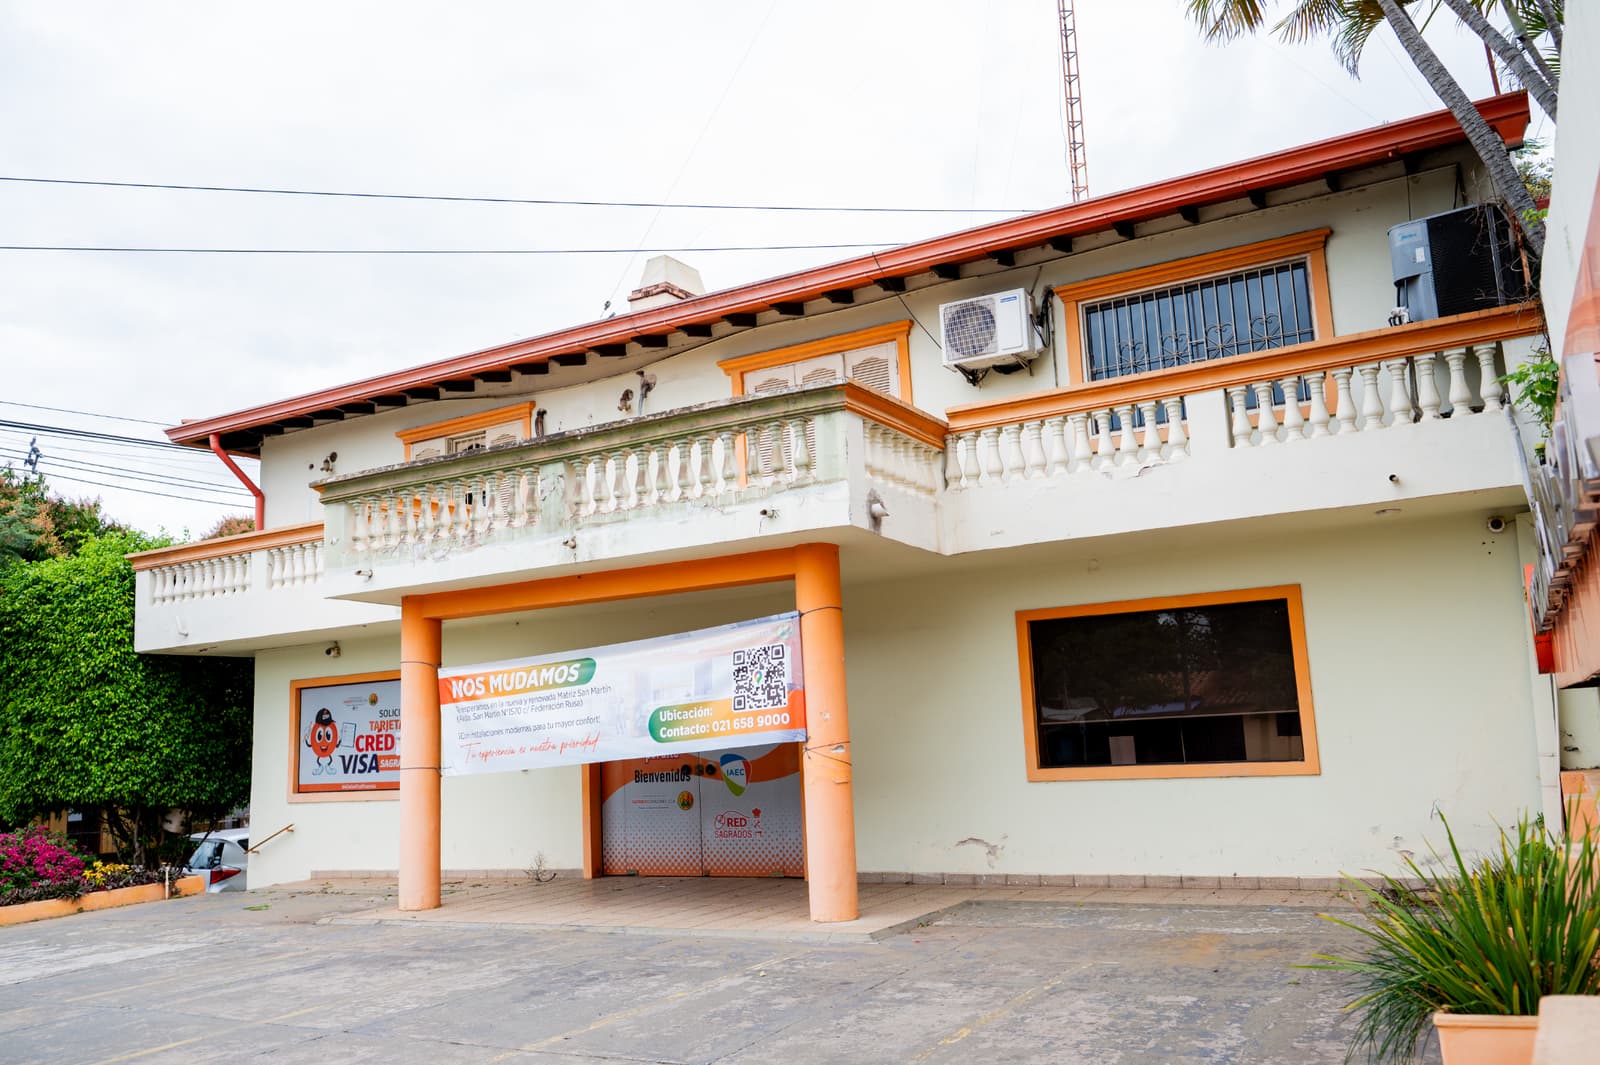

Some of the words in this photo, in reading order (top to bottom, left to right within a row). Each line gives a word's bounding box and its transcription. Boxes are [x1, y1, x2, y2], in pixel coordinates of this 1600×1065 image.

[452, 676, 486, 699] NOS
[489, 663, 582, 693] MUDAMOS
[557, 689, 577, 700] Matriz
[577, 688, 589, 697] San
[472, 711, 484, 721] San
[659, 705, 713, 722] Ubicación:
[532, 723, 547, 732] para
[547, 721, 554, 730] tu
[555, 718, 575, 730] mayor
[659, 723, 711, 739] Contacto:
[712, 719, 731, 733] 021
[733, 716, 754, 730] 658
[757, 712, 791, 727] 9000
[338, 753, 380, 774] VISA
[634, 768, 691, 783] Bienvenidos
[726, 768, 745, 777] IAEC
[726, 817, 747, 828] RED
[714, 829, 753, 839] SAGRADOS
